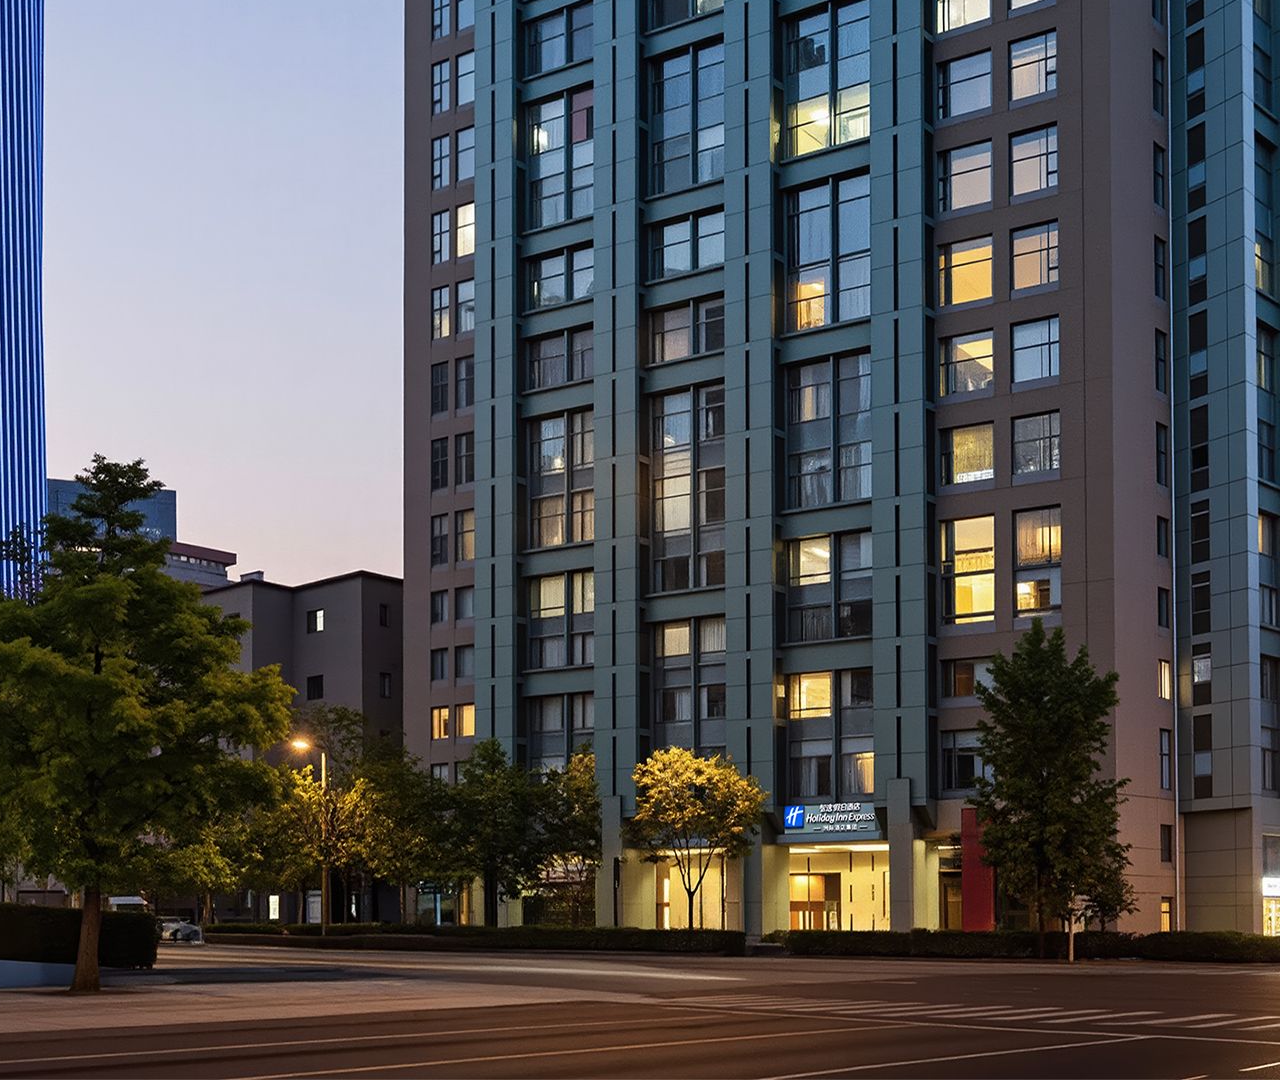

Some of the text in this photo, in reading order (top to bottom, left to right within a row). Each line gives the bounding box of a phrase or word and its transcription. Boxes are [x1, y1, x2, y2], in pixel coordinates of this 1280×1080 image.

[805, 812, 875, 824] Holiday Inn Express
